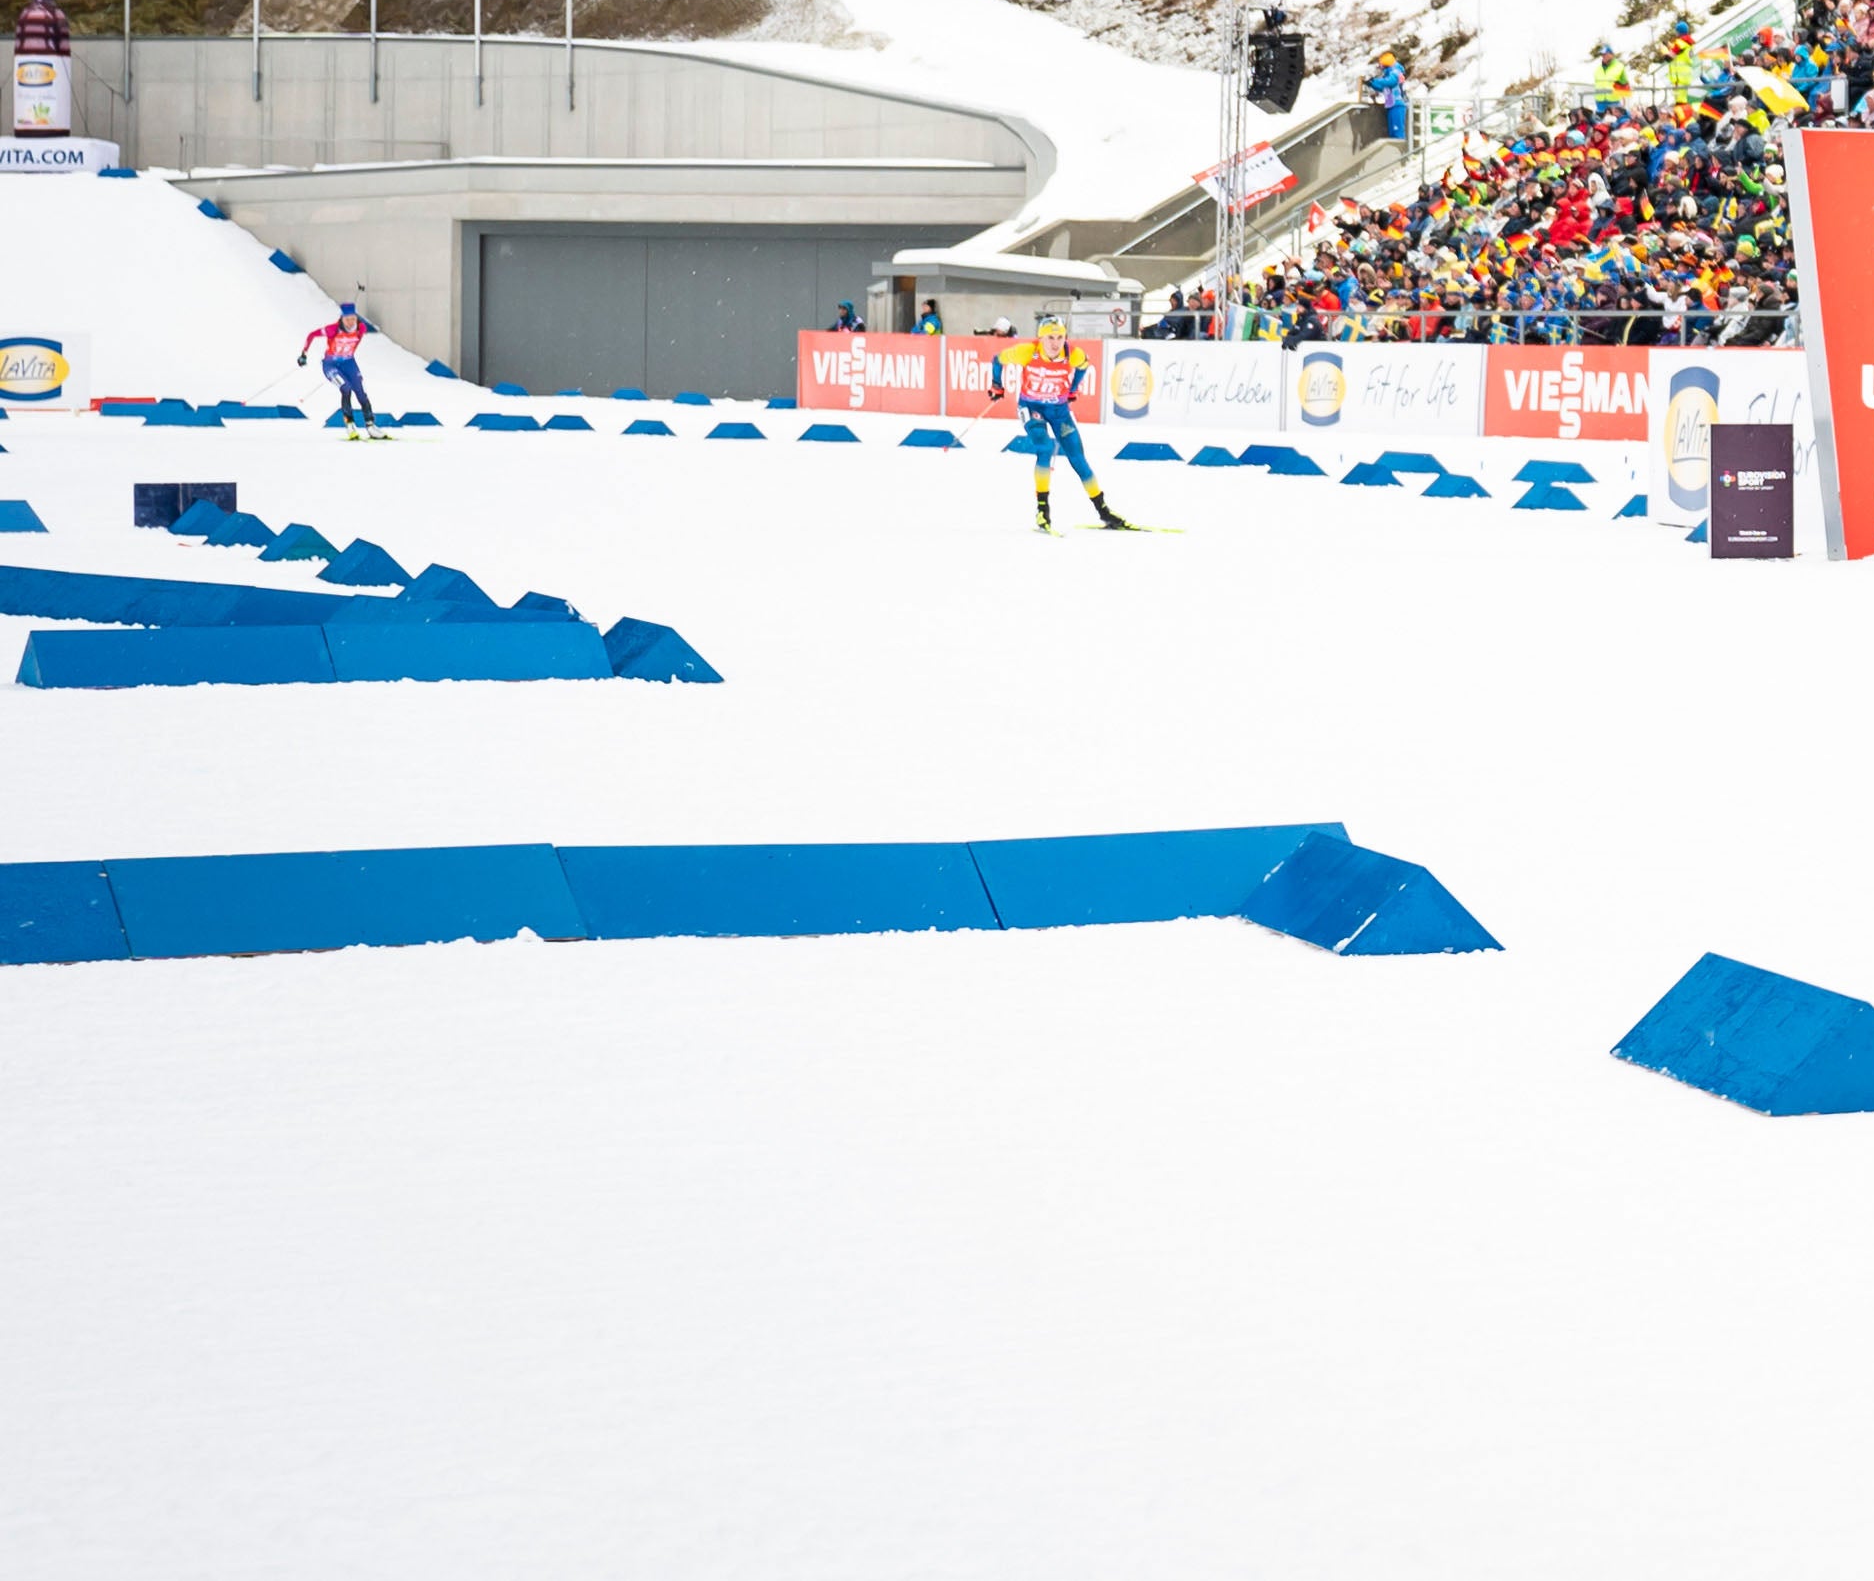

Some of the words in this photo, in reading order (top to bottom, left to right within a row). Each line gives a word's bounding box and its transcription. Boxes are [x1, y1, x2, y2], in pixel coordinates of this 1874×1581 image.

[1224, 360, 1272, 404] Leben
[1392, 364, 1420, 418] for
[1504, 351, 1649, 438] VIESSMAN
